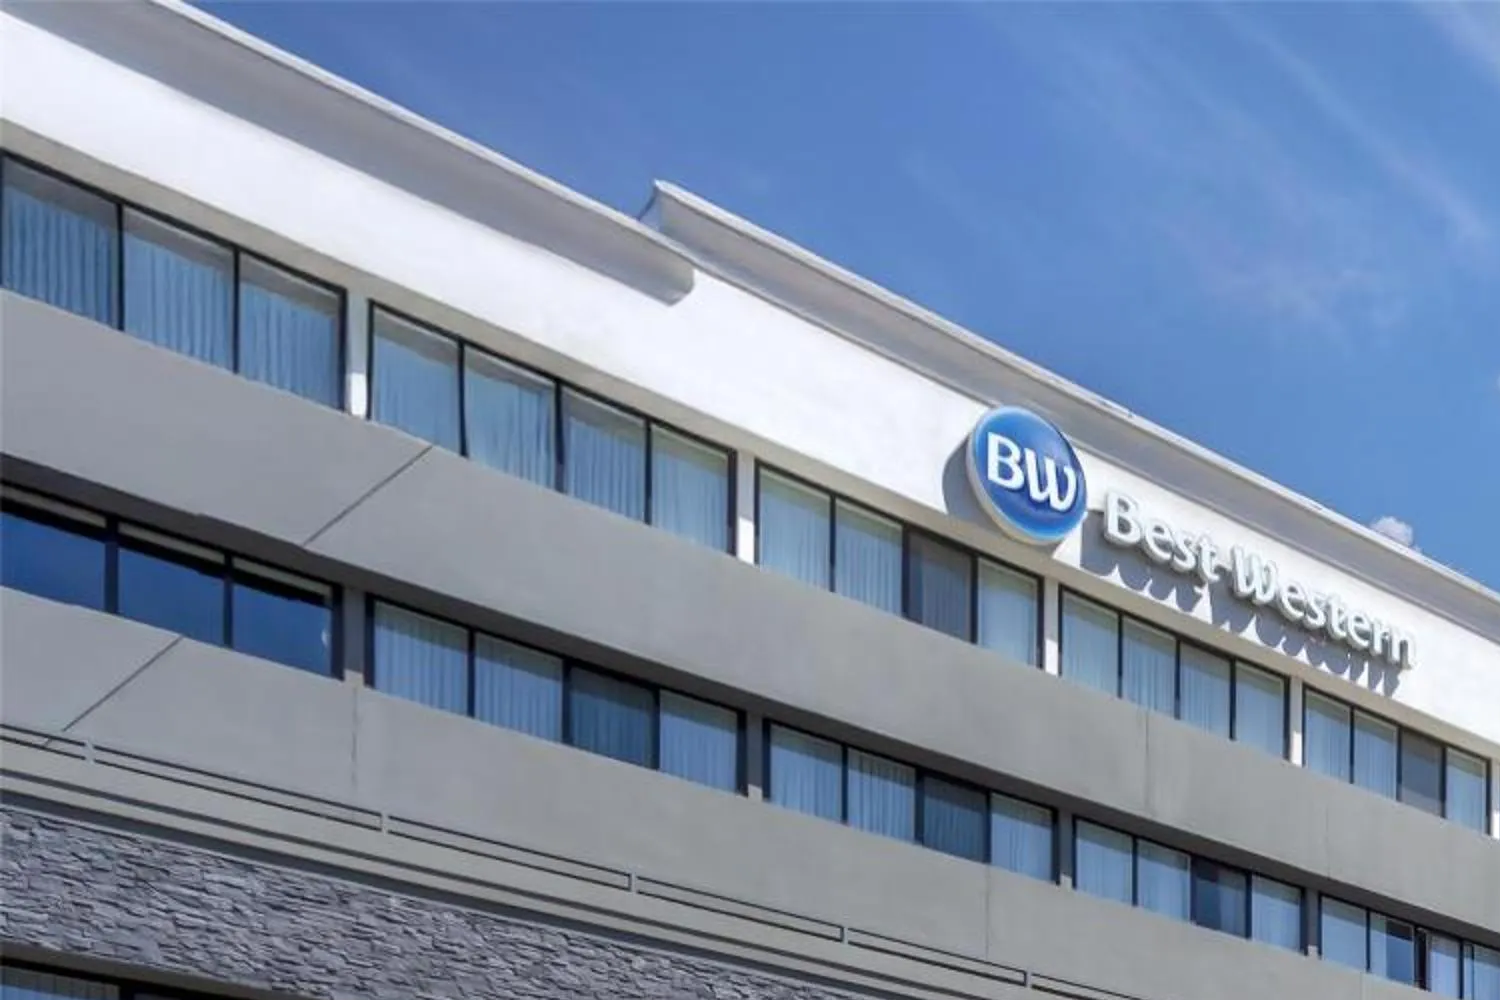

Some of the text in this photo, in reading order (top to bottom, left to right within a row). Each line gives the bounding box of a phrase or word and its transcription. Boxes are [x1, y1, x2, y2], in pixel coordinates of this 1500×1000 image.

[987, 431, 1077, 511] BW
[1104, 489, 1418, 670] Best Western
